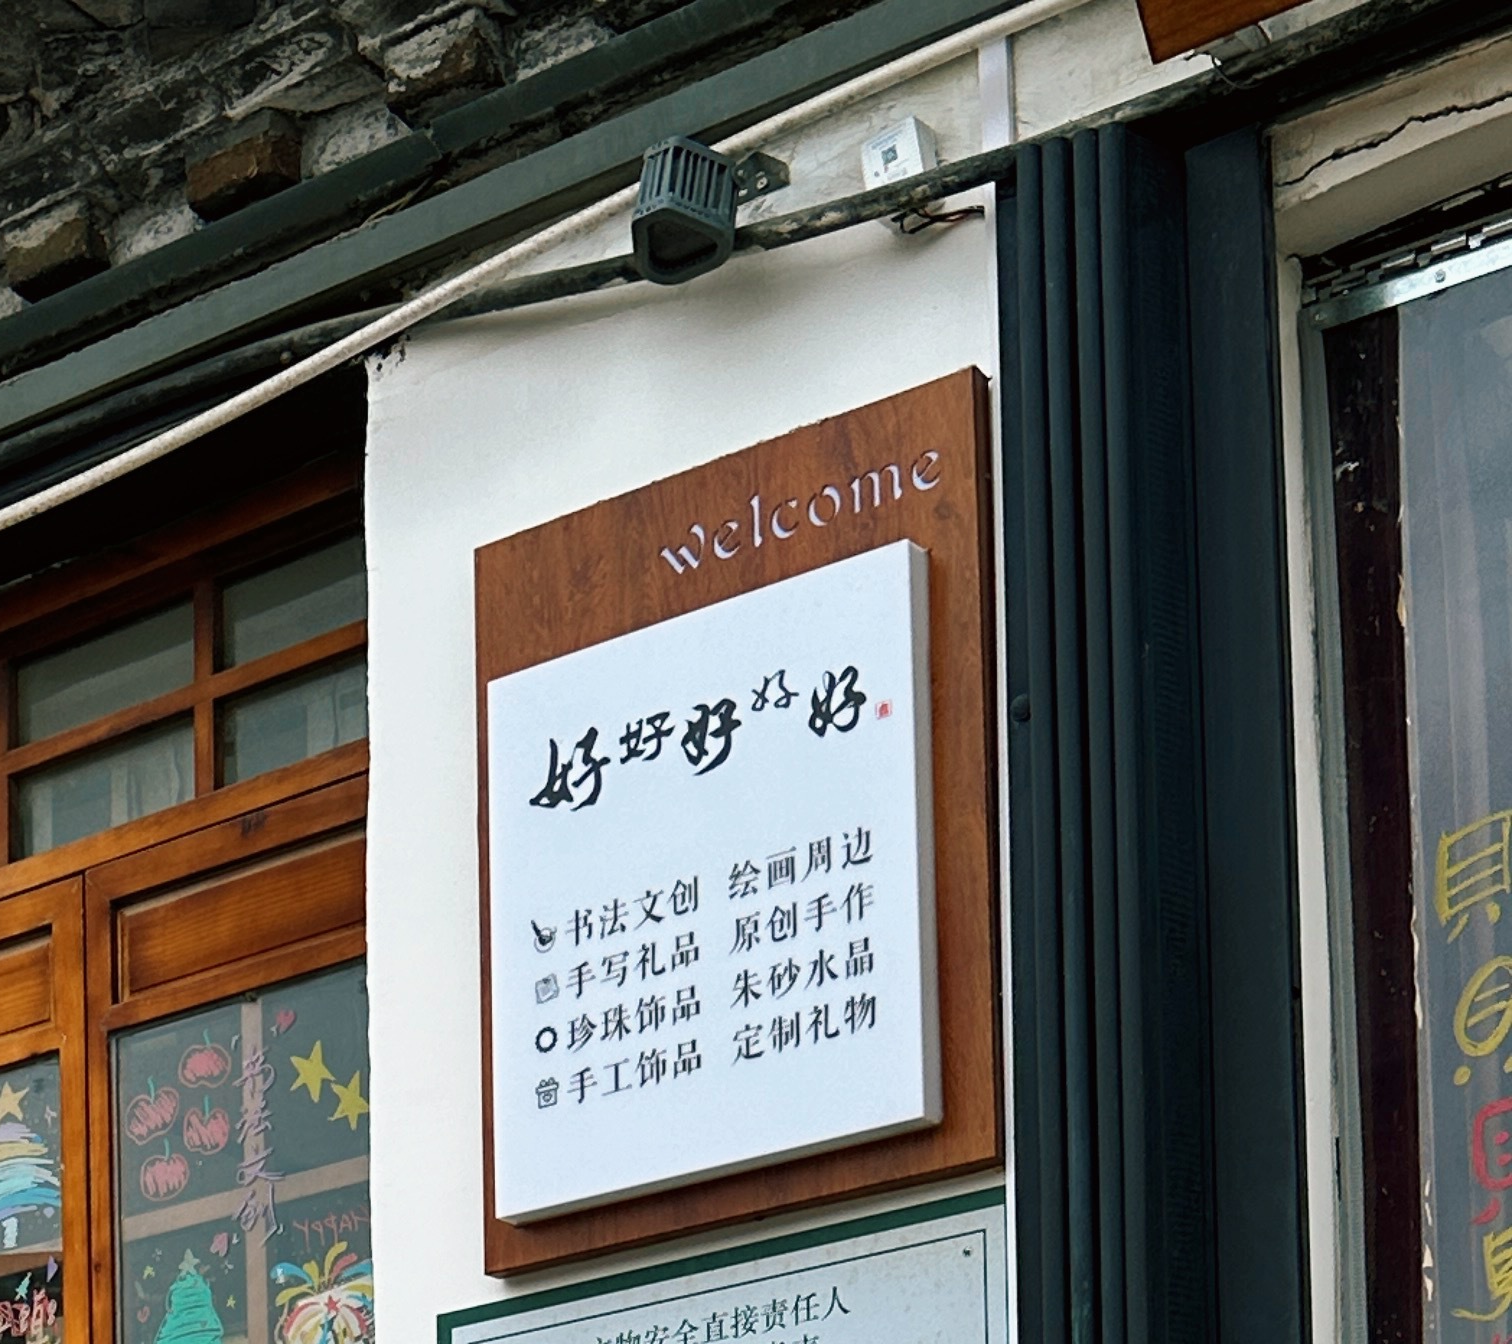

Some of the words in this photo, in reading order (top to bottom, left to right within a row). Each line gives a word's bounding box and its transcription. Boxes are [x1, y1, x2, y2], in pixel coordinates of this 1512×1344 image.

[660, 450, 940, 575] welcome
[565, 875, 699, 947] 书法文创
[728, 827, 874, 900] 绘画周边
[566, 931, 700, 999] 手写礼品
[729, 882, 875, 956] 原创手作
[566, 985, 701, 1053] 珍珠饰品
[730, 937, 874, 1010] 朱砂水晶
[566, 1038, 702, 1104] 手工饰品
[732, 992, 878, 1066] 定制礼物
